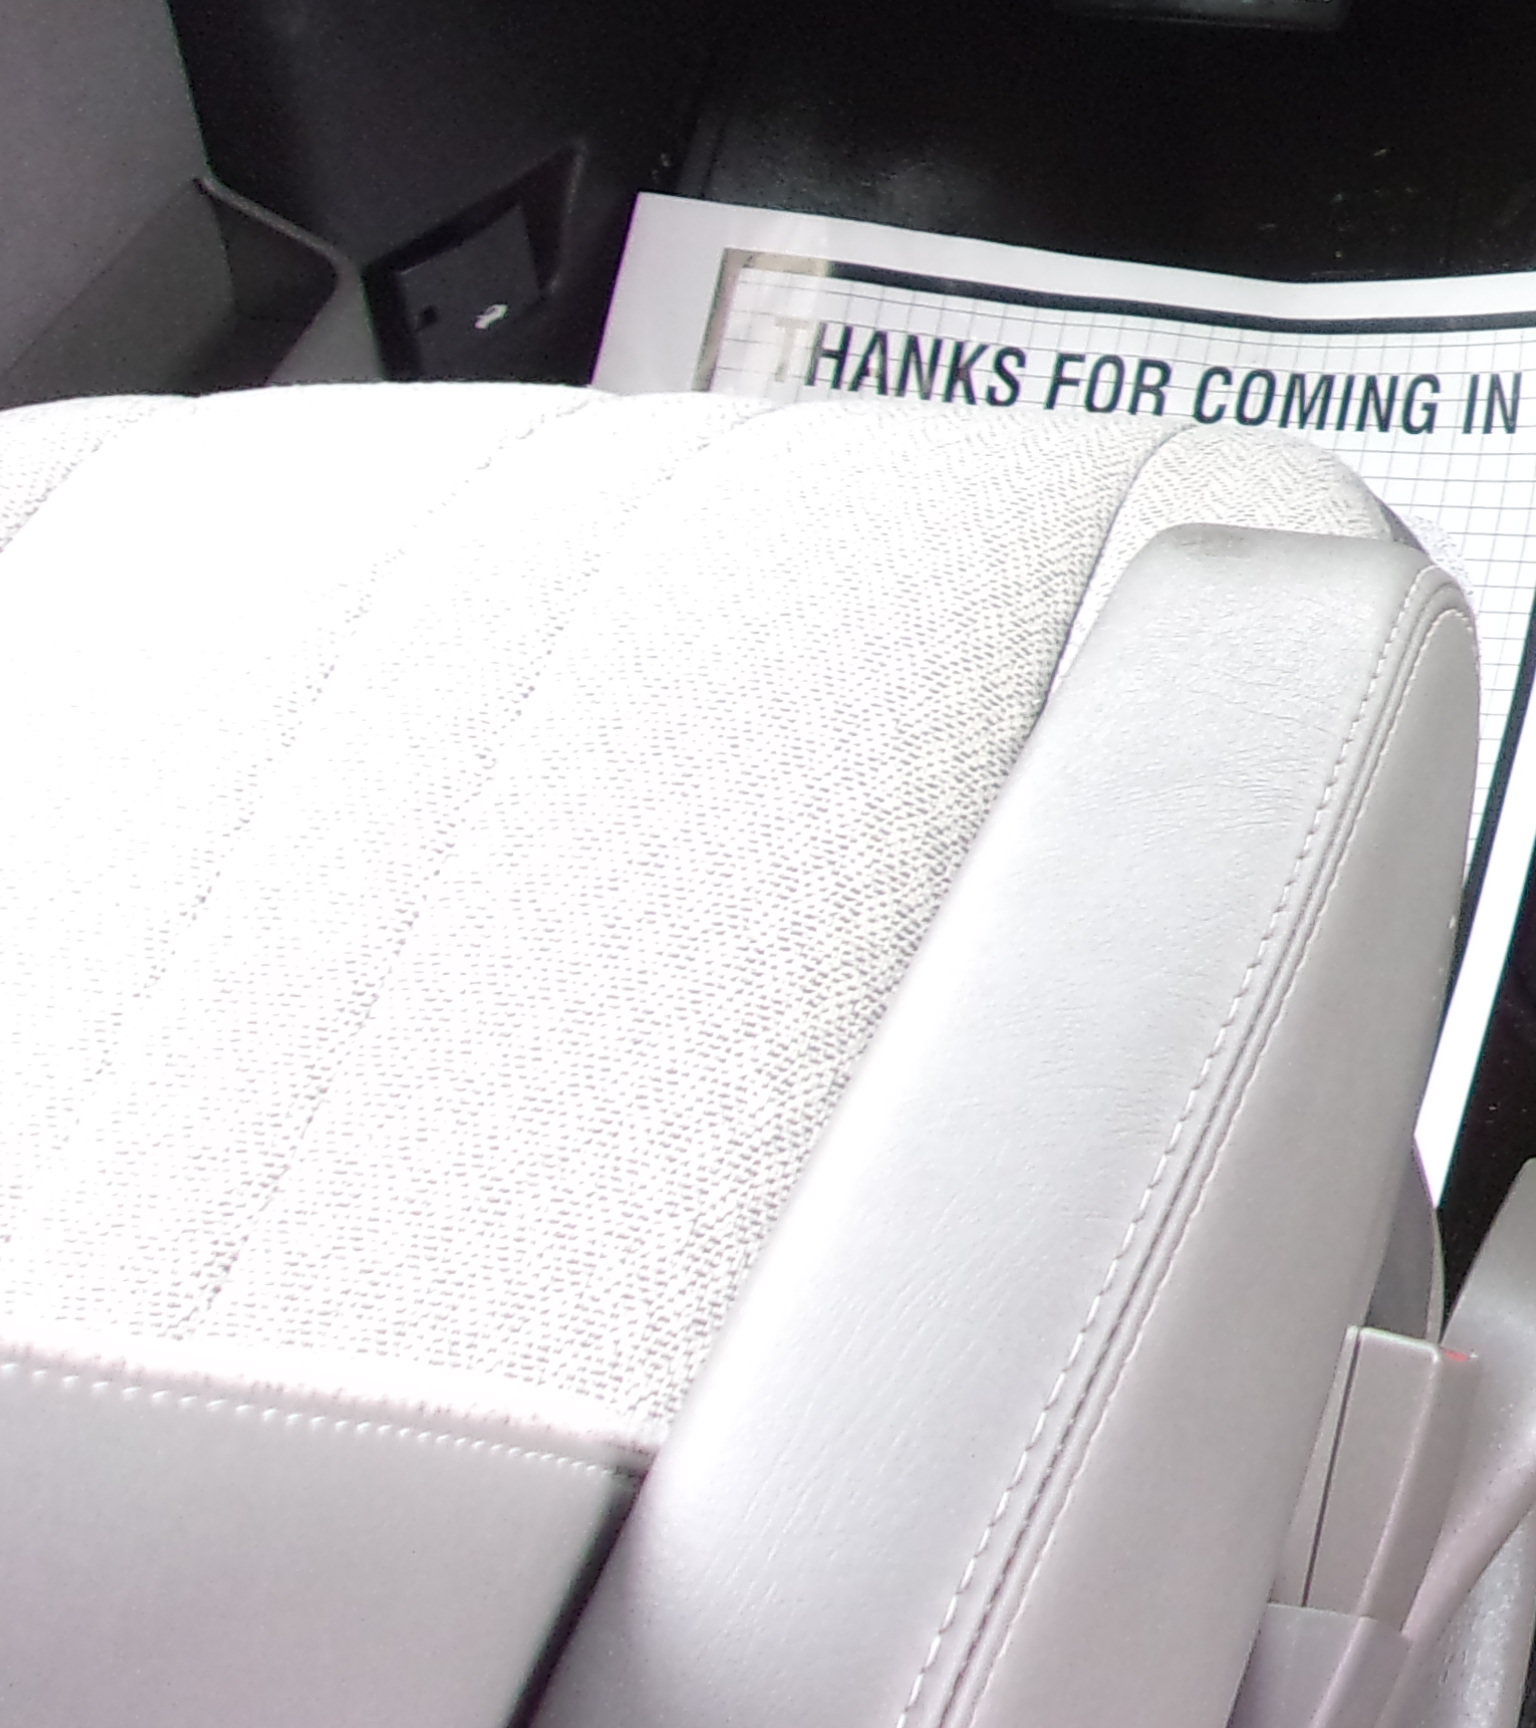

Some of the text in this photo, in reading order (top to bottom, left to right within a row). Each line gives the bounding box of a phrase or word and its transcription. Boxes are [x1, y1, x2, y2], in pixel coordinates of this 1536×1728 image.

[774, 316, 1522, 435] THANKS FOR COMING IN
